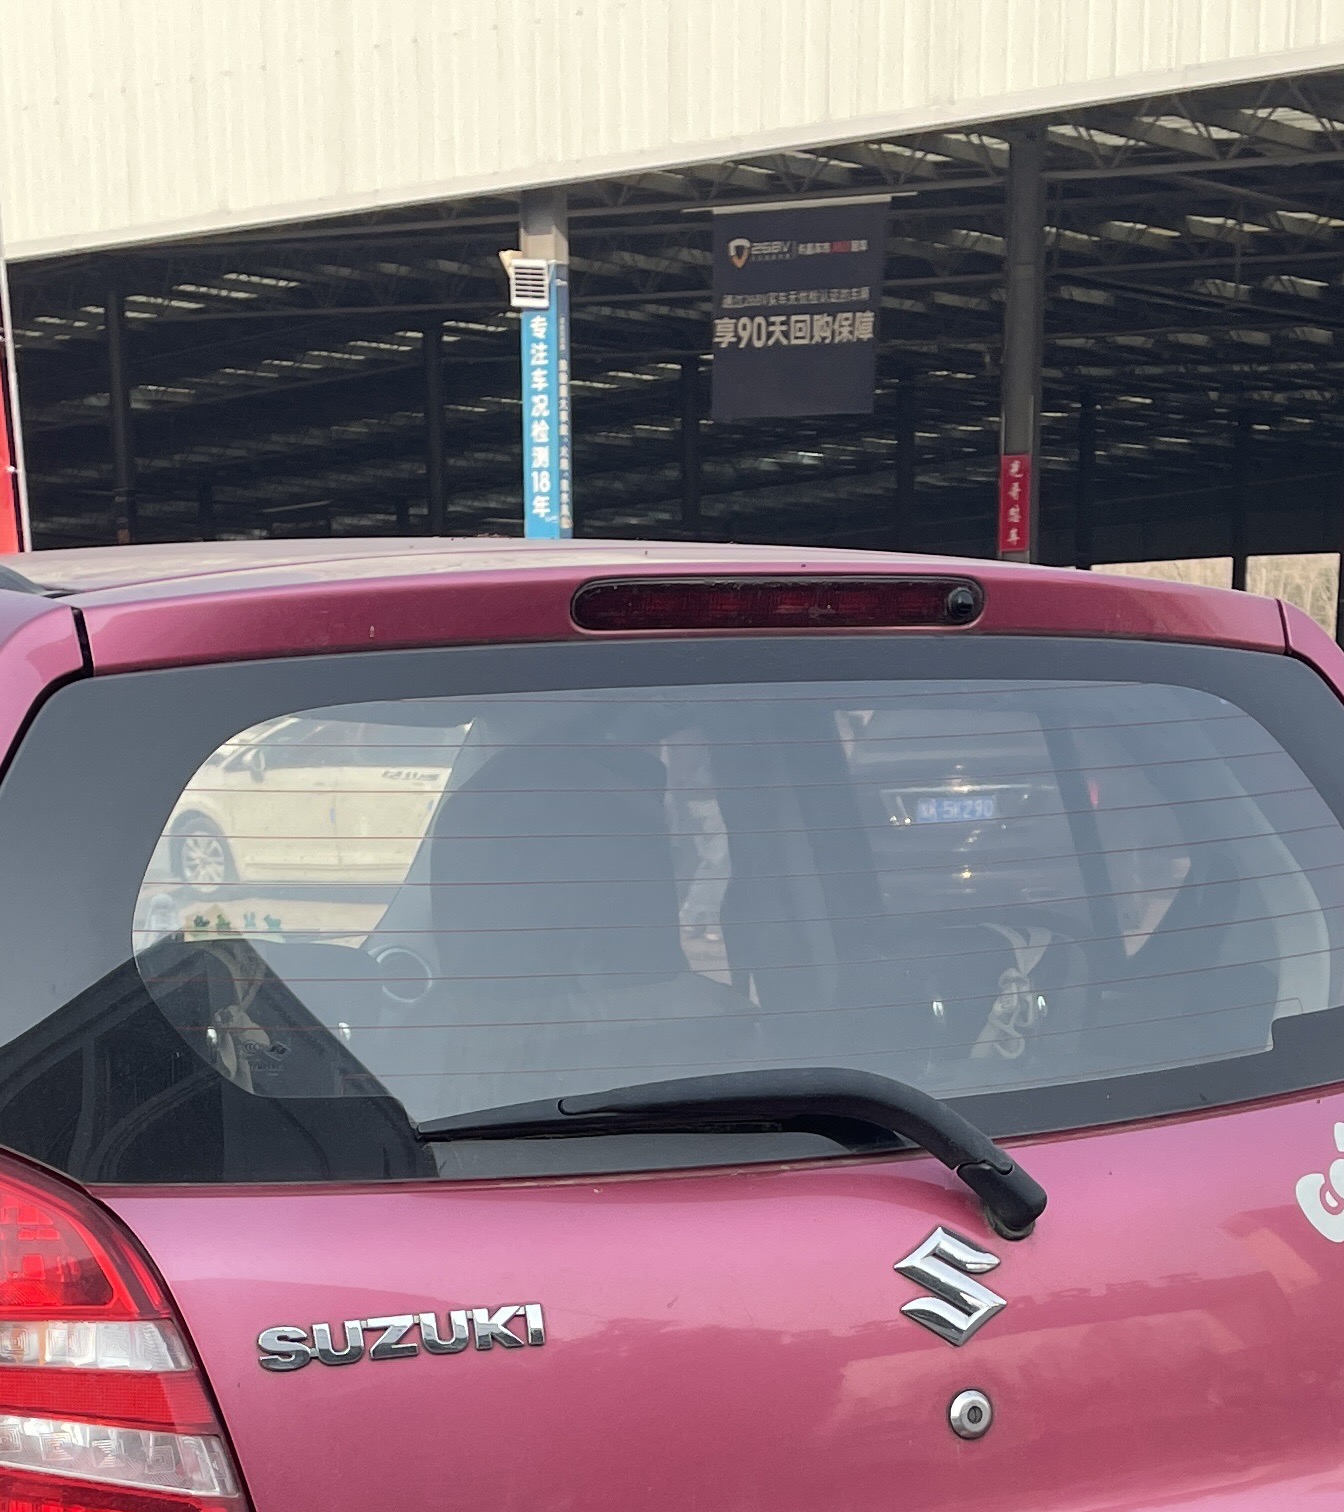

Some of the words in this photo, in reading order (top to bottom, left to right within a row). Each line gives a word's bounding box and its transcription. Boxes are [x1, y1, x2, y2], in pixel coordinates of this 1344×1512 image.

[712, 310, 875, 349] 享90天回购保障
[529, 315, 552, 519] 专注车况检测18年
[257, 1302, 547, 1372] SUZUKI
